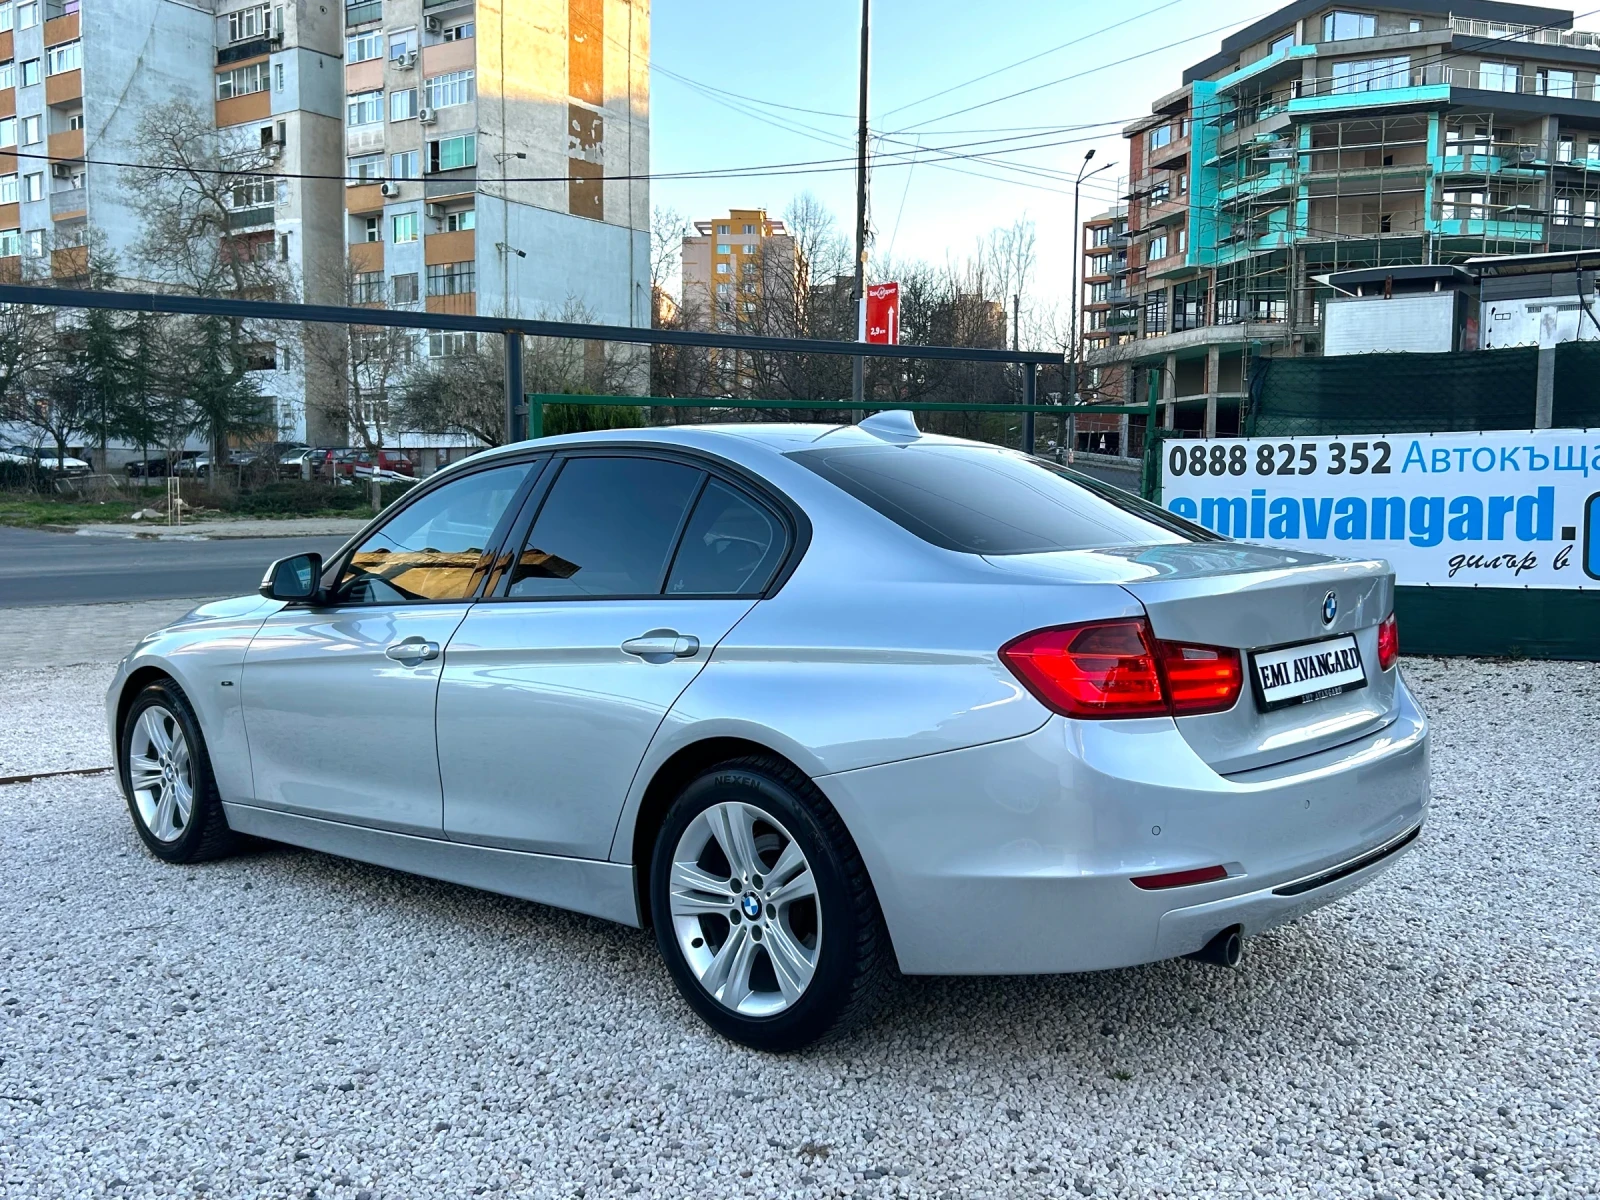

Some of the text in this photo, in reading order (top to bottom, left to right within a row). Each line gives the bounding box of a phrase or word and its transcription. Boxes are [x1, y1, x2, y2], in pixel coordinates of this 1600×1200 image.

[870, 327, 880, 336] 2,9
[1169, 444, 1247, 477] 0888
[1255, 443, 1317, 476] 825
[1326, 441, 1391, 475] 352
[1448, 544, 1574, 578] дилър в
[1259, 647, 1361, 690] EMI AVANGARD
[714, 775, 761, 789] NEXEN
